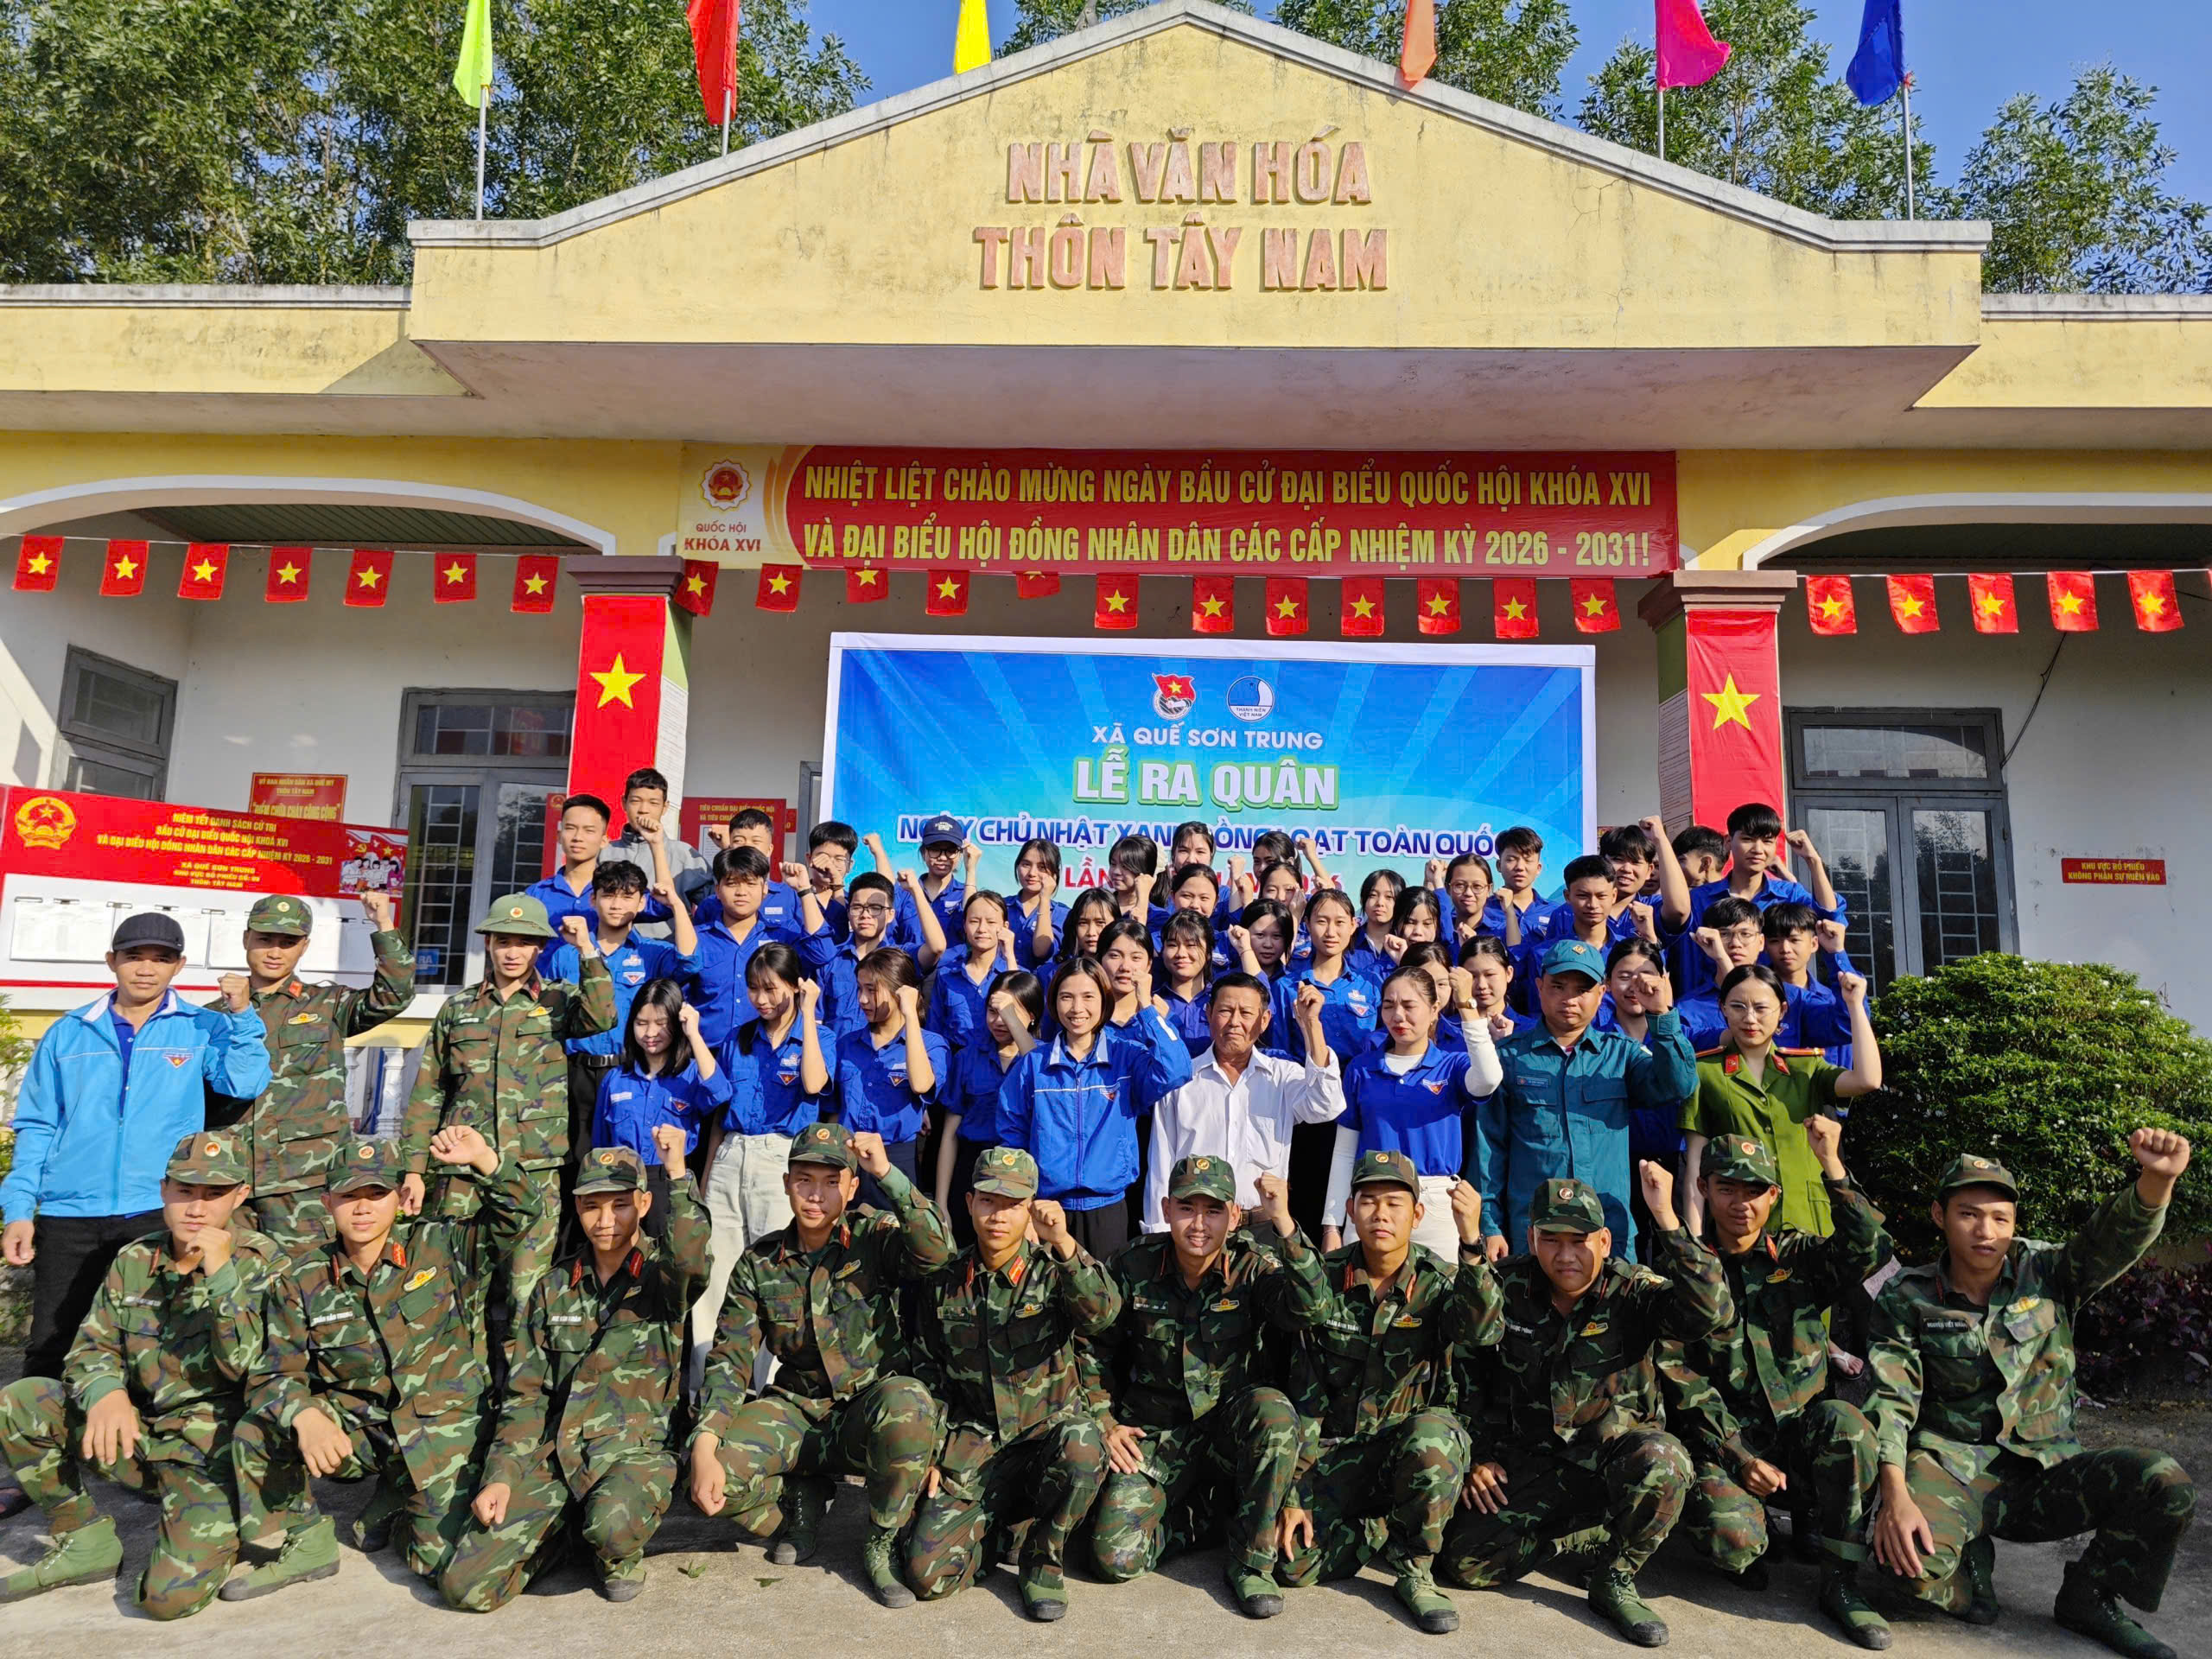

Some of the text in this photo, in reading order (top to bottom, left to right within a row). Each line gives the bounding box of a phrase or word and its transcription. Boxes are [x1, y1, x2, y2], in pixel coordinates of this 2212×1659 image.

[1007, 125, 1371, 203] NHÀ VĂN HÓA
[975, 212, 1388, 289] THÔN TÂY NAM
[804, 457, 1651, 512] NHIỆT LIỆT CHÀO MỪNG NGÀY BẦU CỬ ĐẠI BIỂU QUỐC HỘI KHÓA XVI
[683, 536, 761, 552] KHÓA XVI
[695, 521, 747, 535] QUỐC HỘI
[804, 518, 836, 558] VÀ
[842, 524, 883, 566] ĐẠI
[893, 512, 950, 560] BIỂU
[959, 518, 1001, 568] HỘI
[1009, 516, 1078, 562] ĐỒNG
[1087, 521, 1160, 563] NHÂN
[1168, 522, 1221, 563] DÂN
[1230, 522, 1281, 563] CÁC
[1289, 516, 1341, 563] CẤP
[1350, 522, 1435, 571] NHIỆM
[1444, 523, 1478, 565] KỲ
[1485, 531, 1549, 566] 2026
[1575, 531, 1649, 568] 2031!
[1092, 721, 1324, 750] XÃ QUẾ SƠN TRUNG
[1076, 748, 1337, 807] LỄ RA QUÂN
[900, 817, 975, 840] NY
[980, 815, 1032, 842] CHỦ
[1038, 817, 1111, 848] NHẬT
[1355, 826, 1431, 855] TOÀN
[1436, 825, 1500, 856] QUỐ
[1065, 856, 1115, 887] LẦN
